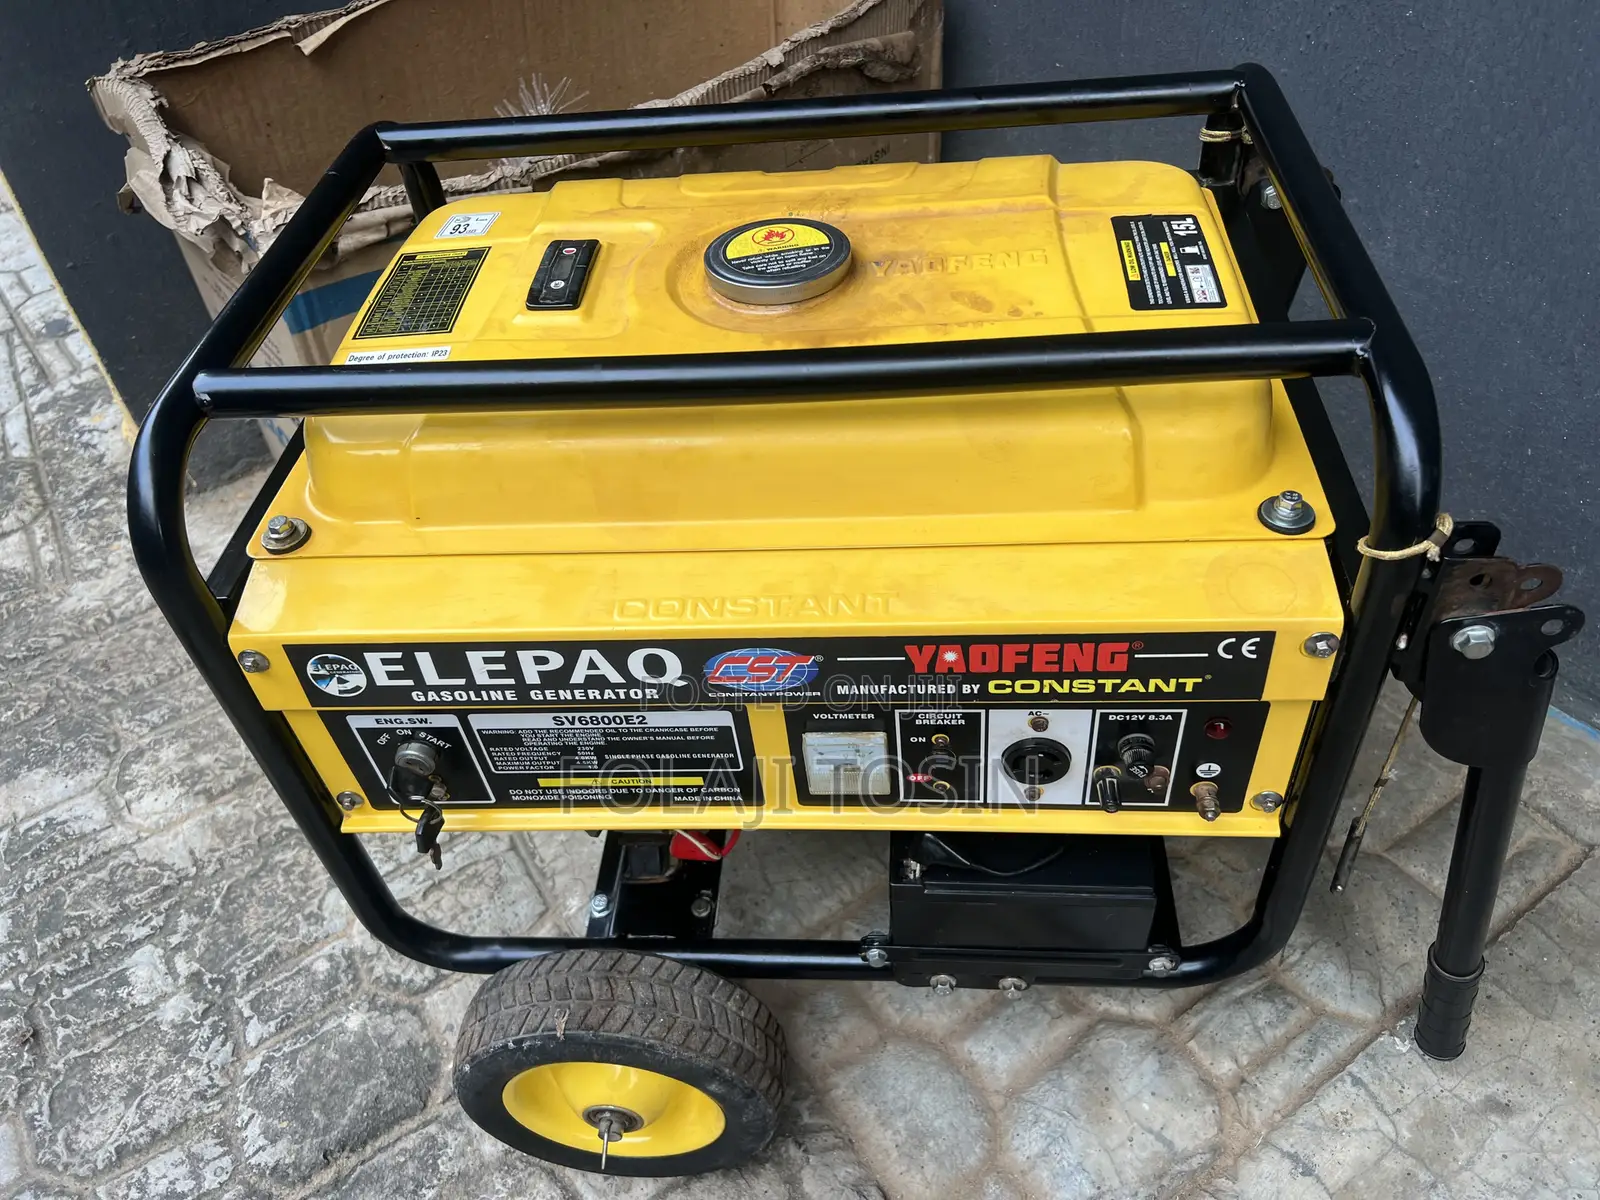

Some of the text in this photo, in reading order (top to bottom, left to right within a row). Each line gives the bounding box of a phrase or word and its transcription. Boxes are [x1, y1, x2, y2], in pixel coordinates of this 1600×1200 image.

[450, 223, 470, 235] 93
[1170, 217, 1198, 236] 15L
[767, 243, 799, 251] WARNING
[870, 250, 1048, 278] YAOFENG
[348, 354, 375, 363] Degree
[387, 351, 429, 360] protection:
[431, 349, 448, 357] IP23
[612, 593, 898, 622] CONSTANT
[1216, 637, 1260, 660] CE
[364, 647, 688, 687] ELEPAQ
[905, 642, 1130, 674] YAOFENG
[411, 687, 659, 702] GASOLINE GENERATOR
[836, 677, 1203, 695] MANUFACTURED BY CONSTANT
[551, 715, 649, 727] SV6800E2
[376, 732, 391, 746] OFF
[418, 731, 453, 750] START
